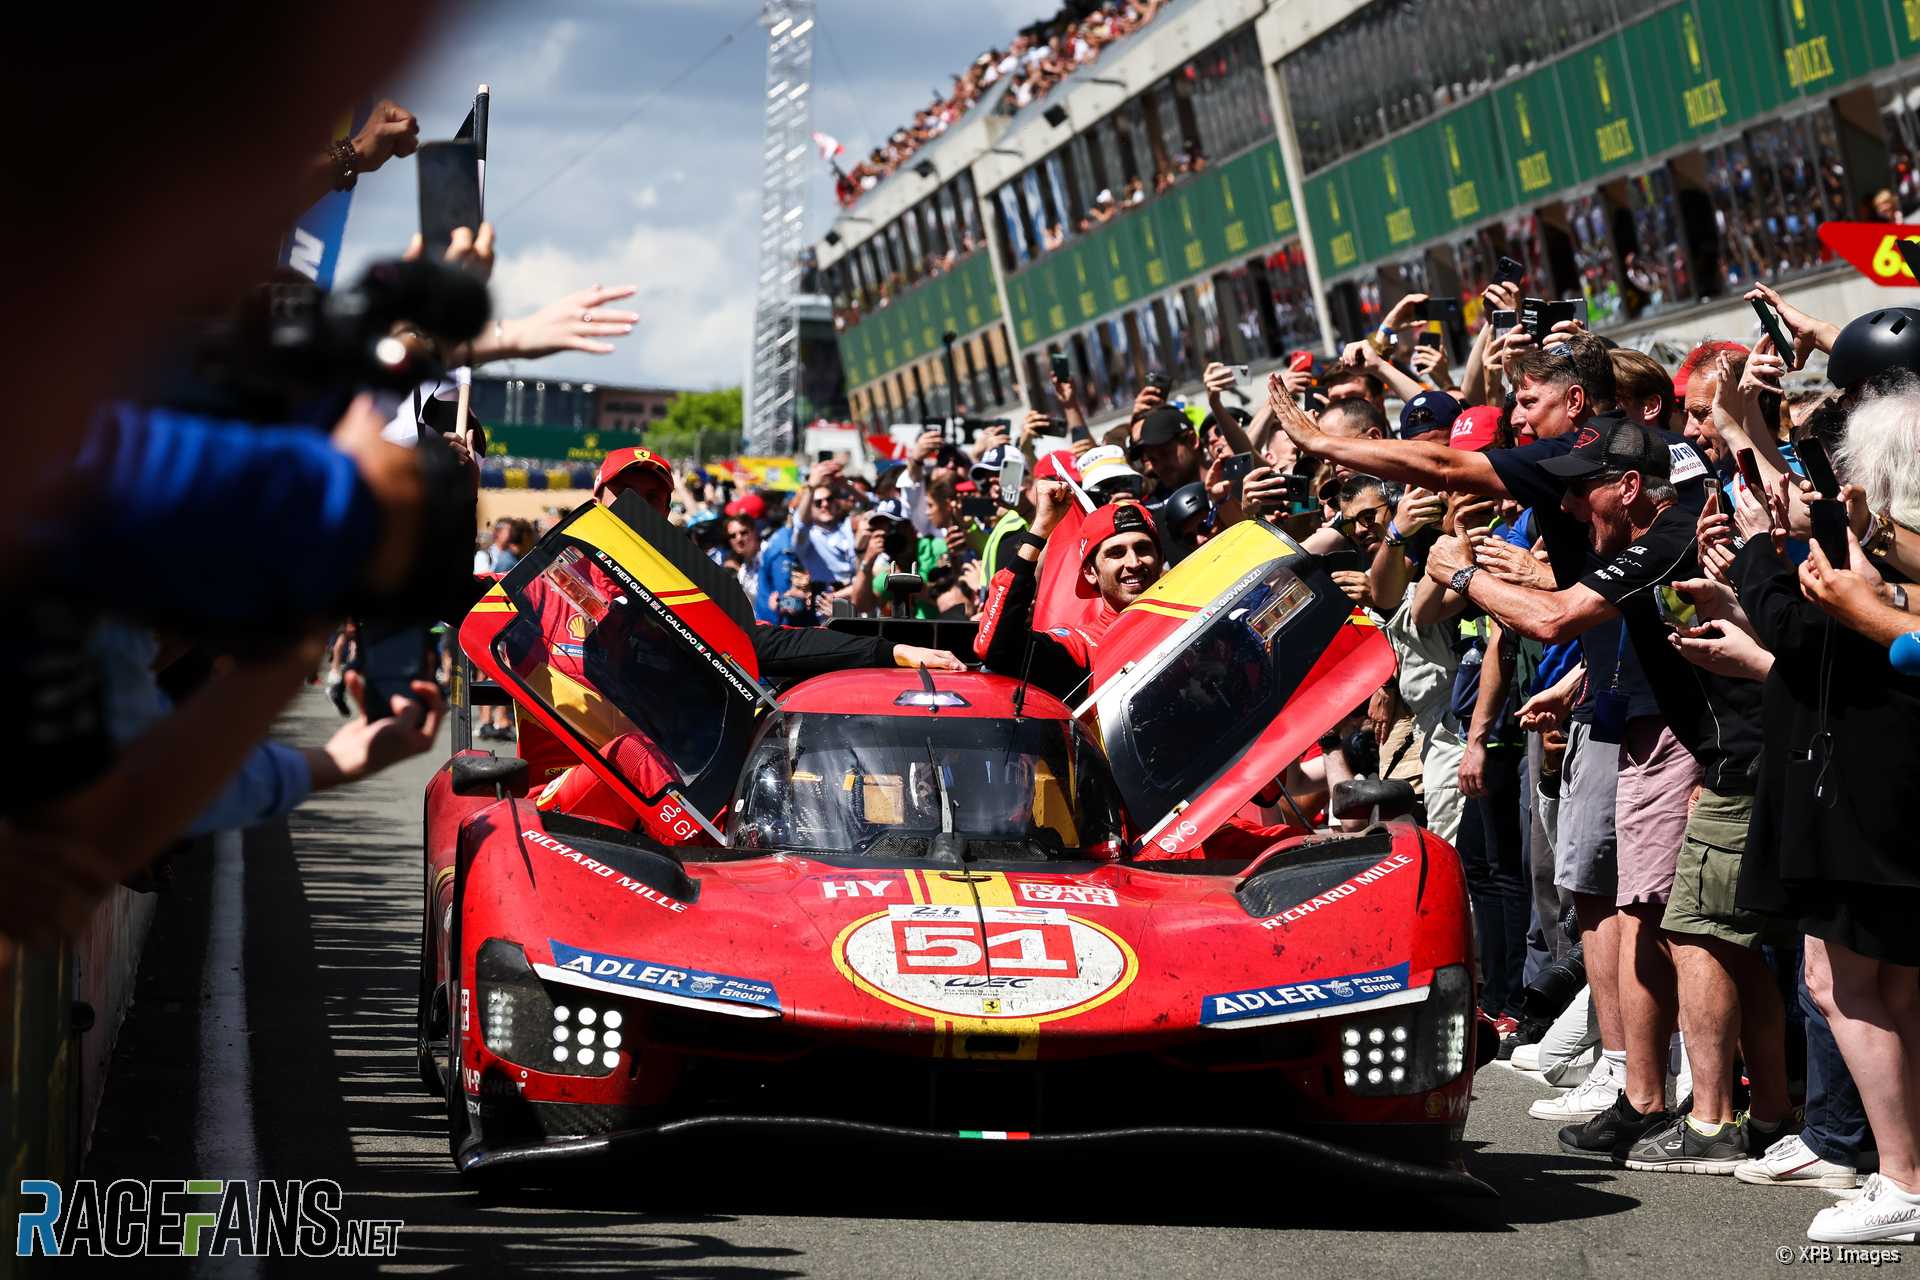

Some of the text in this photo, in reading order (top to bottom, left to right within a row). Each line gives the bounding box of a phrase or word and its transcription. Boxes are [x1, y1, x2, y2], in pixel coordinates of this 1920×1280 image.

[604, 559, 652, 603] A. PIER GUIDI
[1219, 569, 1262, 607] GIOVINAZZI
[657, 609, 698, 645] J. CALADO
[703, 653, 754, 701] A. GIOVINAZZI
[1159, 821, 1198, 852] SYS
[521, 830, 688, 913] RICHARD MILLE
[822, 880, 893, 898] HY
[1028, 890, 1112, 904] CAR
[1260, 854, 1413, 930] RICHARD MILLE
[903, 926, 1068, 971] 51
[560, 955, 688, 988] ADLER
[725, 980, 772, 994] PELZER
[944, 977, 1034, 989] WEC
[1352, 975, 1395, 986] PELZER
[719, 988, 766, 1002] GROUP
[1215, 984, 1328, 1016] ADLER
[1360, 983, 1402, 993] GROUP
